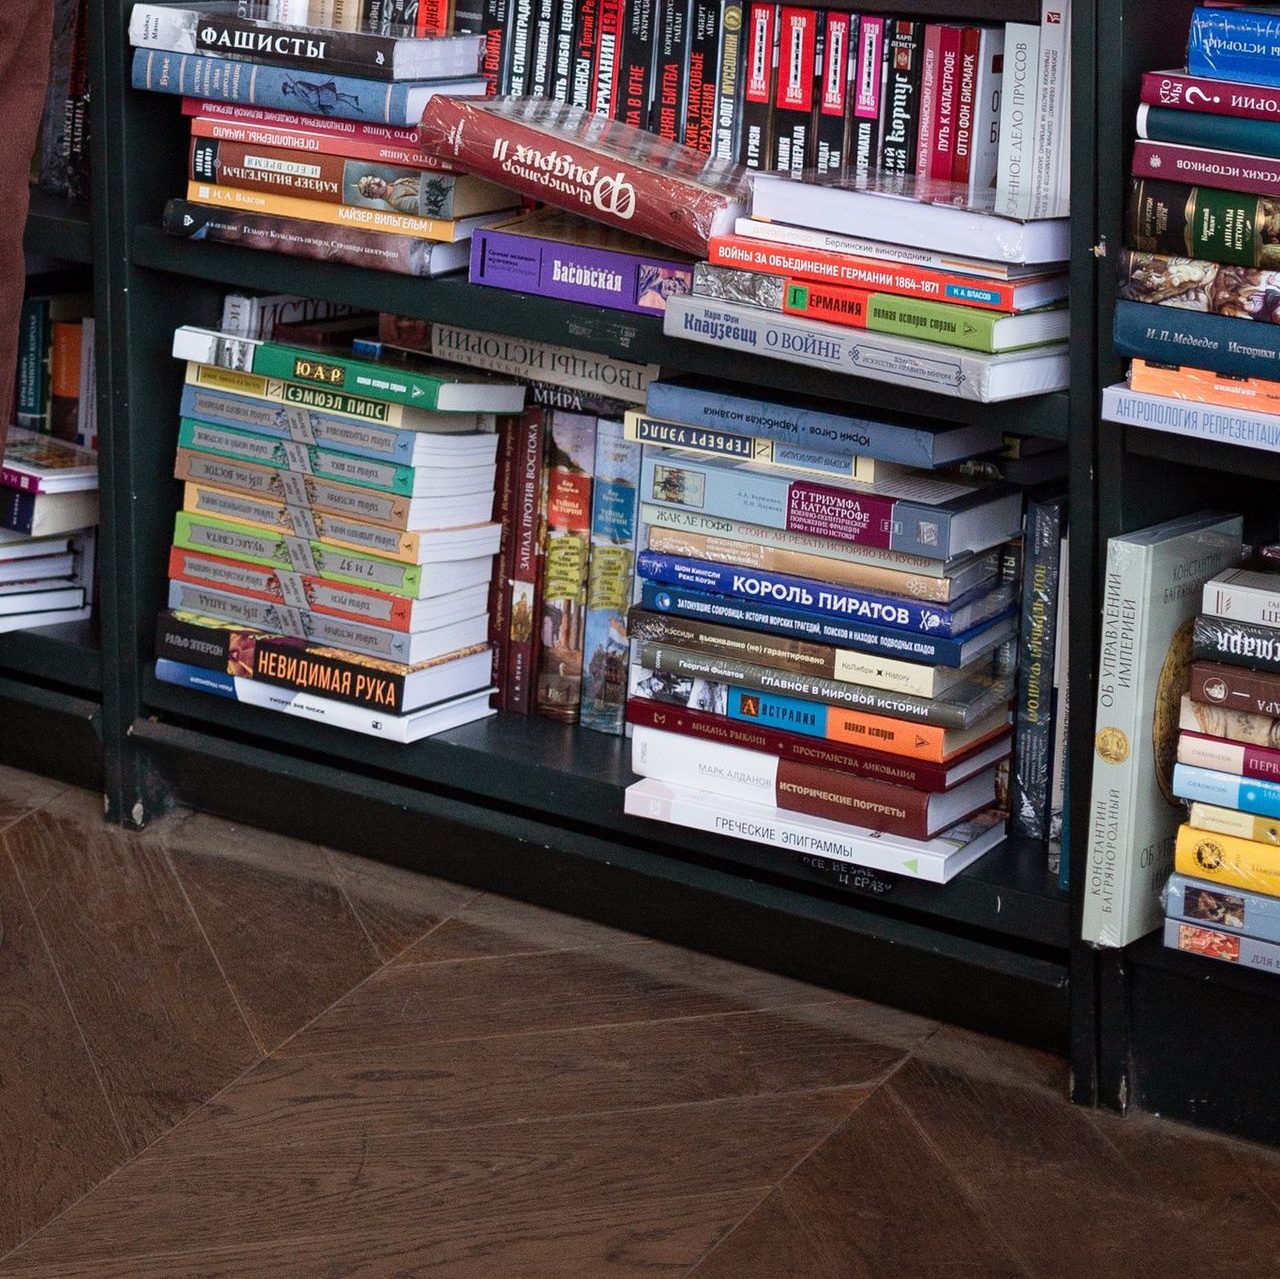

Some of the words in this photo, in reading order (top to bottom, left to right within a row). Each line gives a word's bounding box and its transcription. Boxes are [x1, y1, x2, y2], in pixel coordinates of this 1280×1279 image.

[200, 26, 326, 59] ФАШИСТЫ
[551, 261, 623, 292] Басовская
[718, 247, 752, 262] ВОЙНЫ
[755, 254, 767, 264] ЗА
[769, 254, 839, 277] ОБЪЕДИНЕНИЕ
[842, 267, 894, 284] ГЕРМАНИИ
[895, 274, 940, 293] 1864–1871
[766, 332, 778, 347] О
[782, 334, 842, 360] ВОЙНЕ
[295, 360, 341, 381] ЮАР
[288, 389, 341, 412] СЭМЮЭЛ
[344, 398, 384, 419] ПИПС
[534, 391, 582, 410] МИРА
[1116, 397, 1198, 428] АНТРОПОЛОГИЯ
[732, 574, 812, 606] КОРОЛЬ
[818, 590, 910, 625] ПИРАТОВ
[1102, 572, 1122, 682] УПРАВЛЕНИИ
[1121, 598, 1136, 690] ИМПЕРИЕЙ
[257, 650, 351, 696] НЕВИДИМАЯ
[355, 672, 396, 707] РУКА
[760, 675, 810, 694] ГЛАВНОЕ
[812, 686, 819, 697] В
[822, 687, 875, 707] МИРОВОЙ
[878, 698, 928, 716] ИСТОРИИ
[1100, 688, 1115, 708] ОБ
[739, 697, 817, 728] АВСТРАЛИЯ
[779, 780, 851, 808] ИСТОРИЧЕСКИЕ
[853, 796, 907, 820] ПОРТРЕТЫ
[715, 816, 775, 843] ГРЕЧЕСКИЕ
[782, 829, 853, 859] ЭПИГРАММЫ
[1090, 799, 1108, 897] КОНСТАНТИН
[1101, 789, 1121, 914] БАГРЯНОРОДНЫЙ
